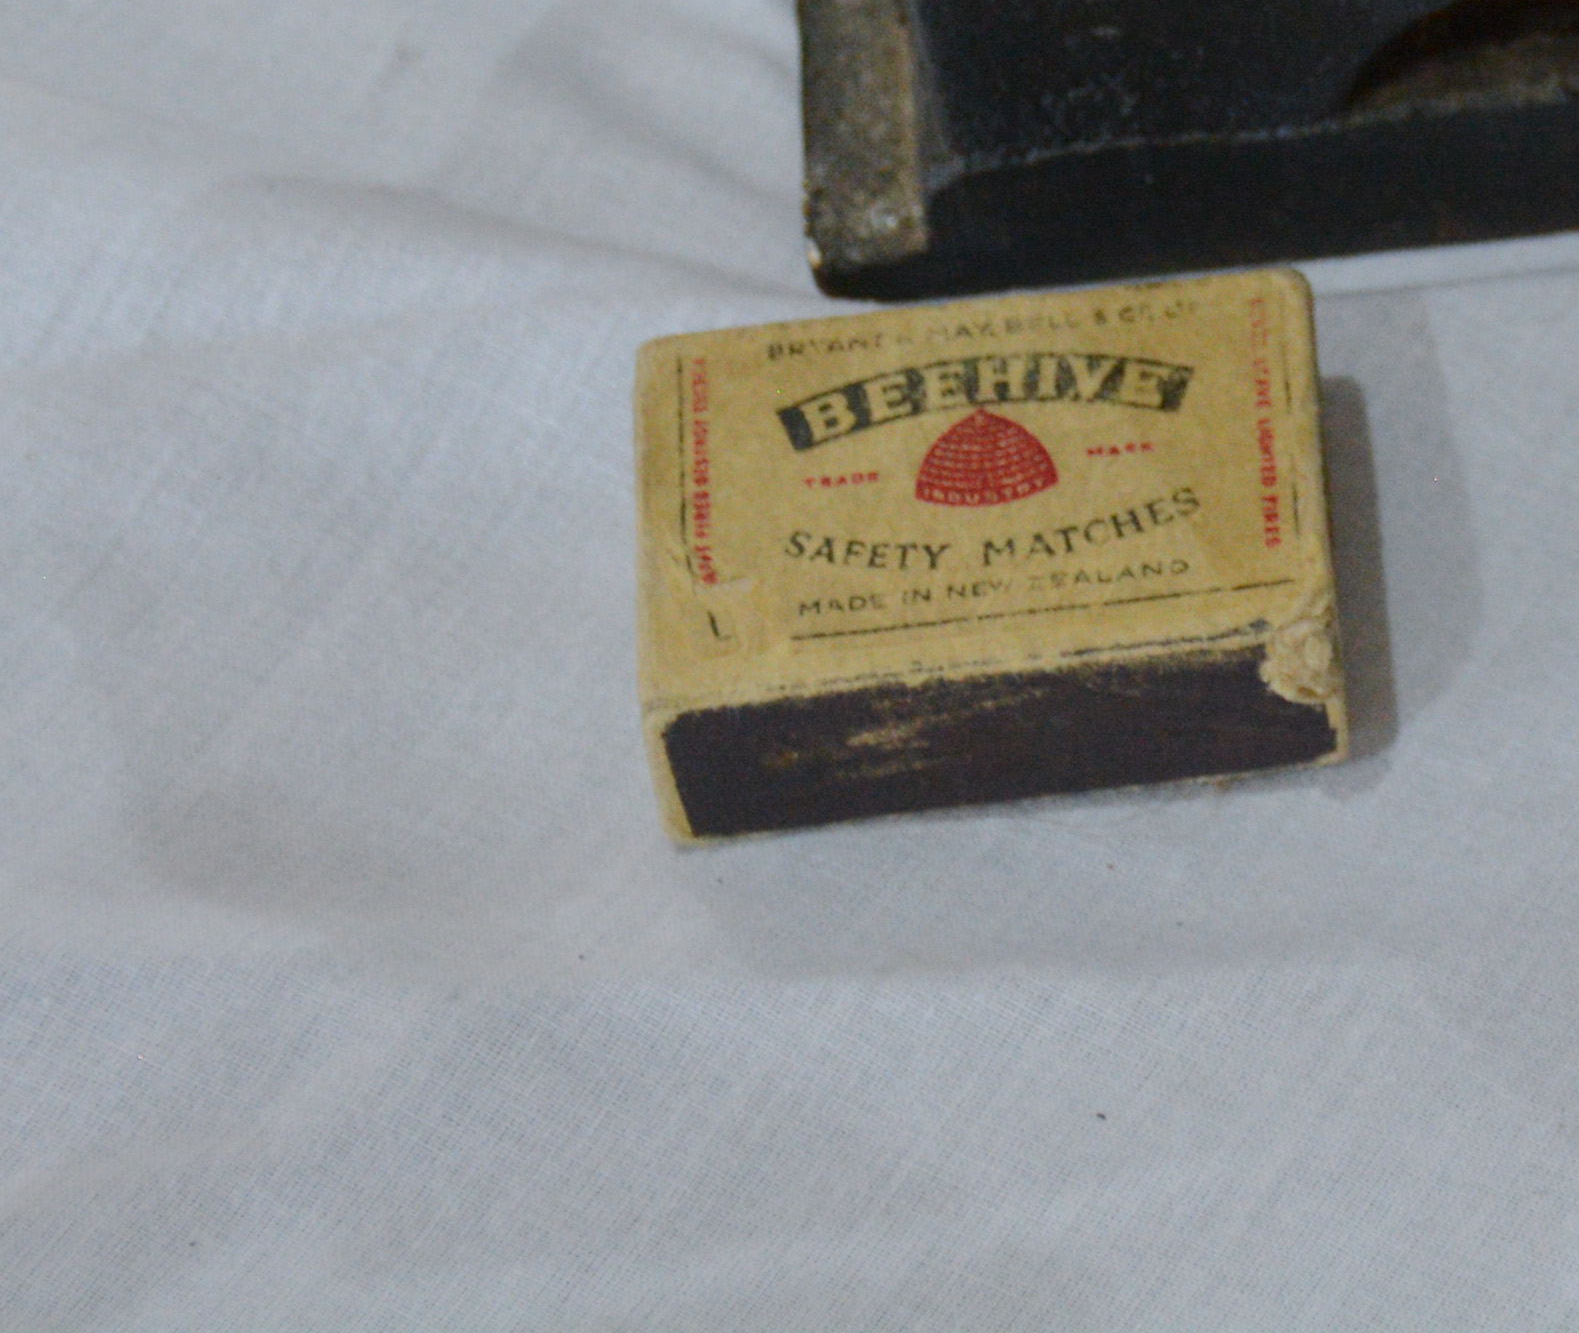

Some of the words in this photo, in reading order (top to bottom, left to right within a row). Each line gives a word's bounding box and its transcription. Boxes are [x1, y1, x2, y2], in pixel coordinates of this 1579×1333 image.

[800, 355, 1170, 445] BEEHIVE
[804, 472, 880, 489] TRADE
[1086, 440, 1153, 457] MARK
[693, 491, 711, 539] FIRES
[920, 479, 1046, 505] INDUSTRY
[785, 530, 952, 571] SAFETY
[982, 486, 1202, 568] MATCHES
[1262, 494, 1281, 548] FIRES
[798, 592, 888, 617] MADE
[901, 586, 932, 605] IN
[946, 579, 1012, 601] NEW
[1027, 558, 1192, 593] ZEALAND
